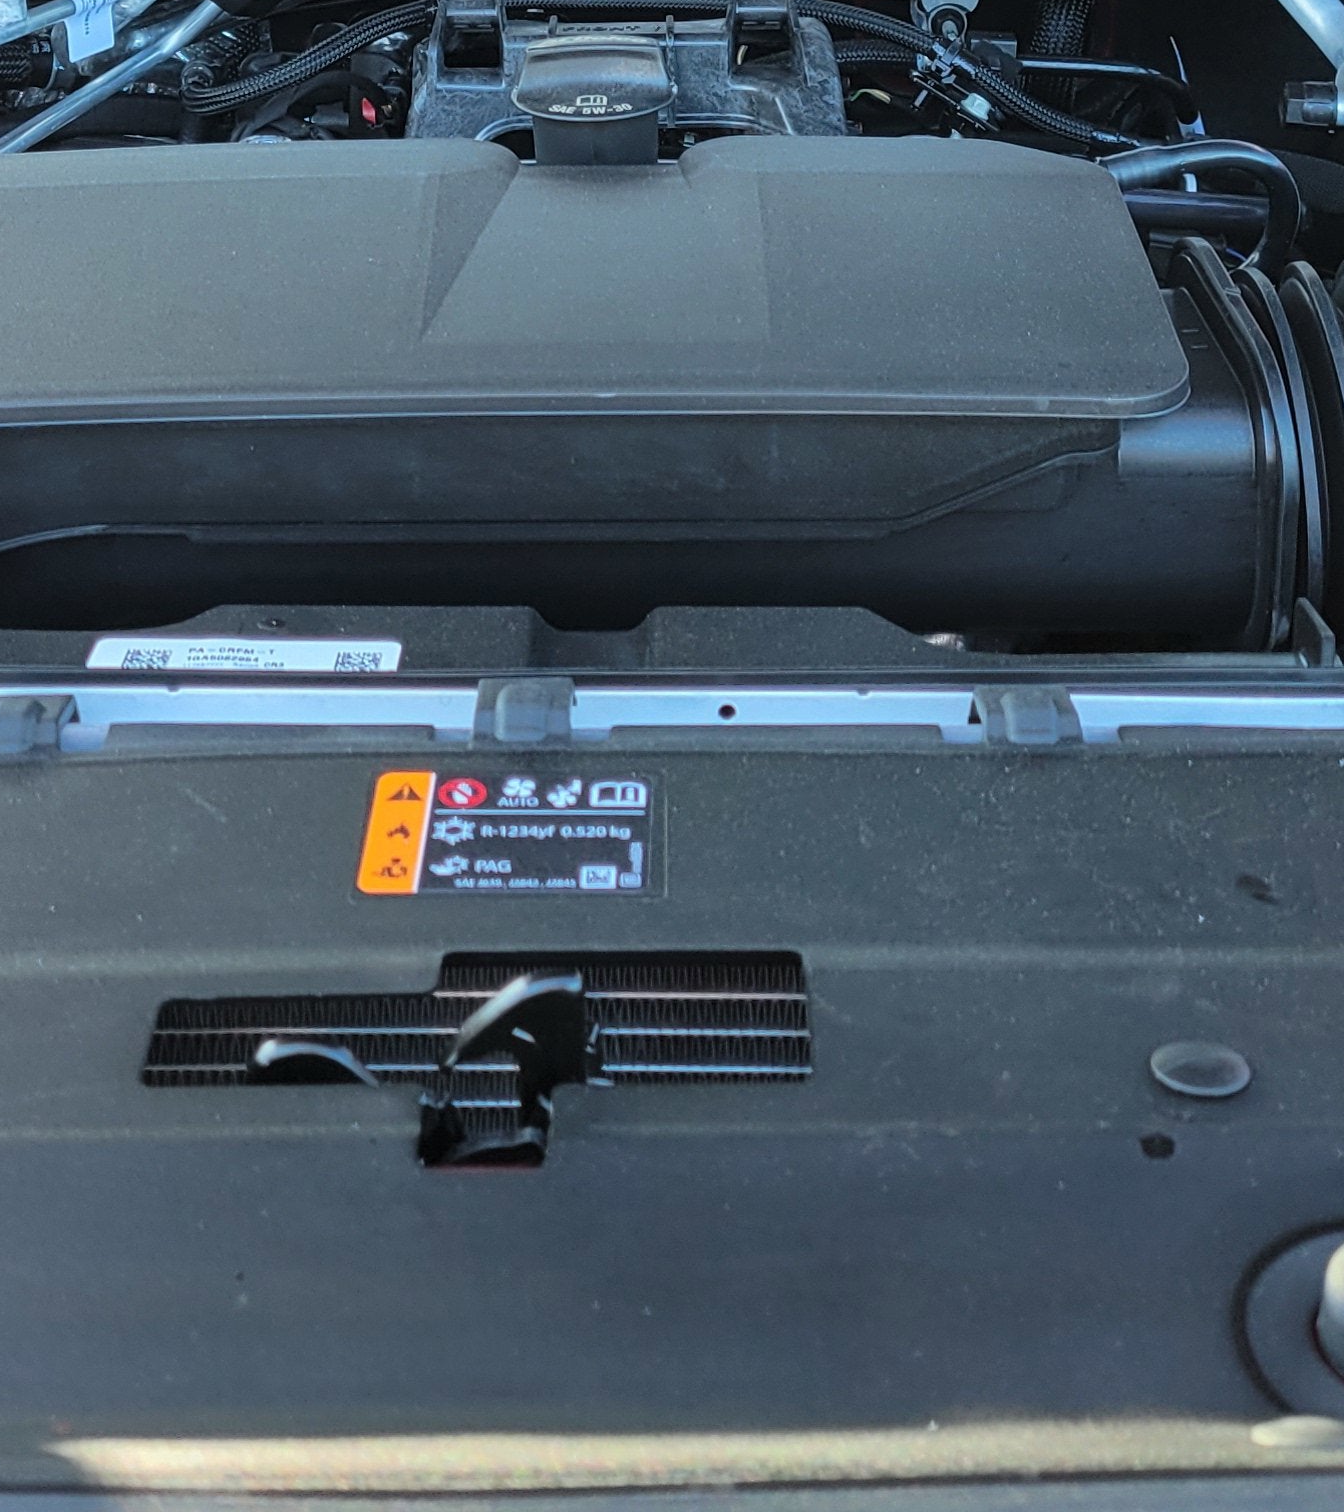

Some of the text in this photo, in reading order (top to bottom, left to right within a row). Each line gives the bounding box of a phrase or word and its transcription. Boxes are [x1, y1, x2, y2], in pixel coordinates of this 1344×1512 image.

[548, 103, 633, 115] SAE 5W-30
[497, 796, 540, 808] AUTO
[480, 823, 632, 841] R-1234yf 0.520 kg
[474, 859, 513, 874] PAG
